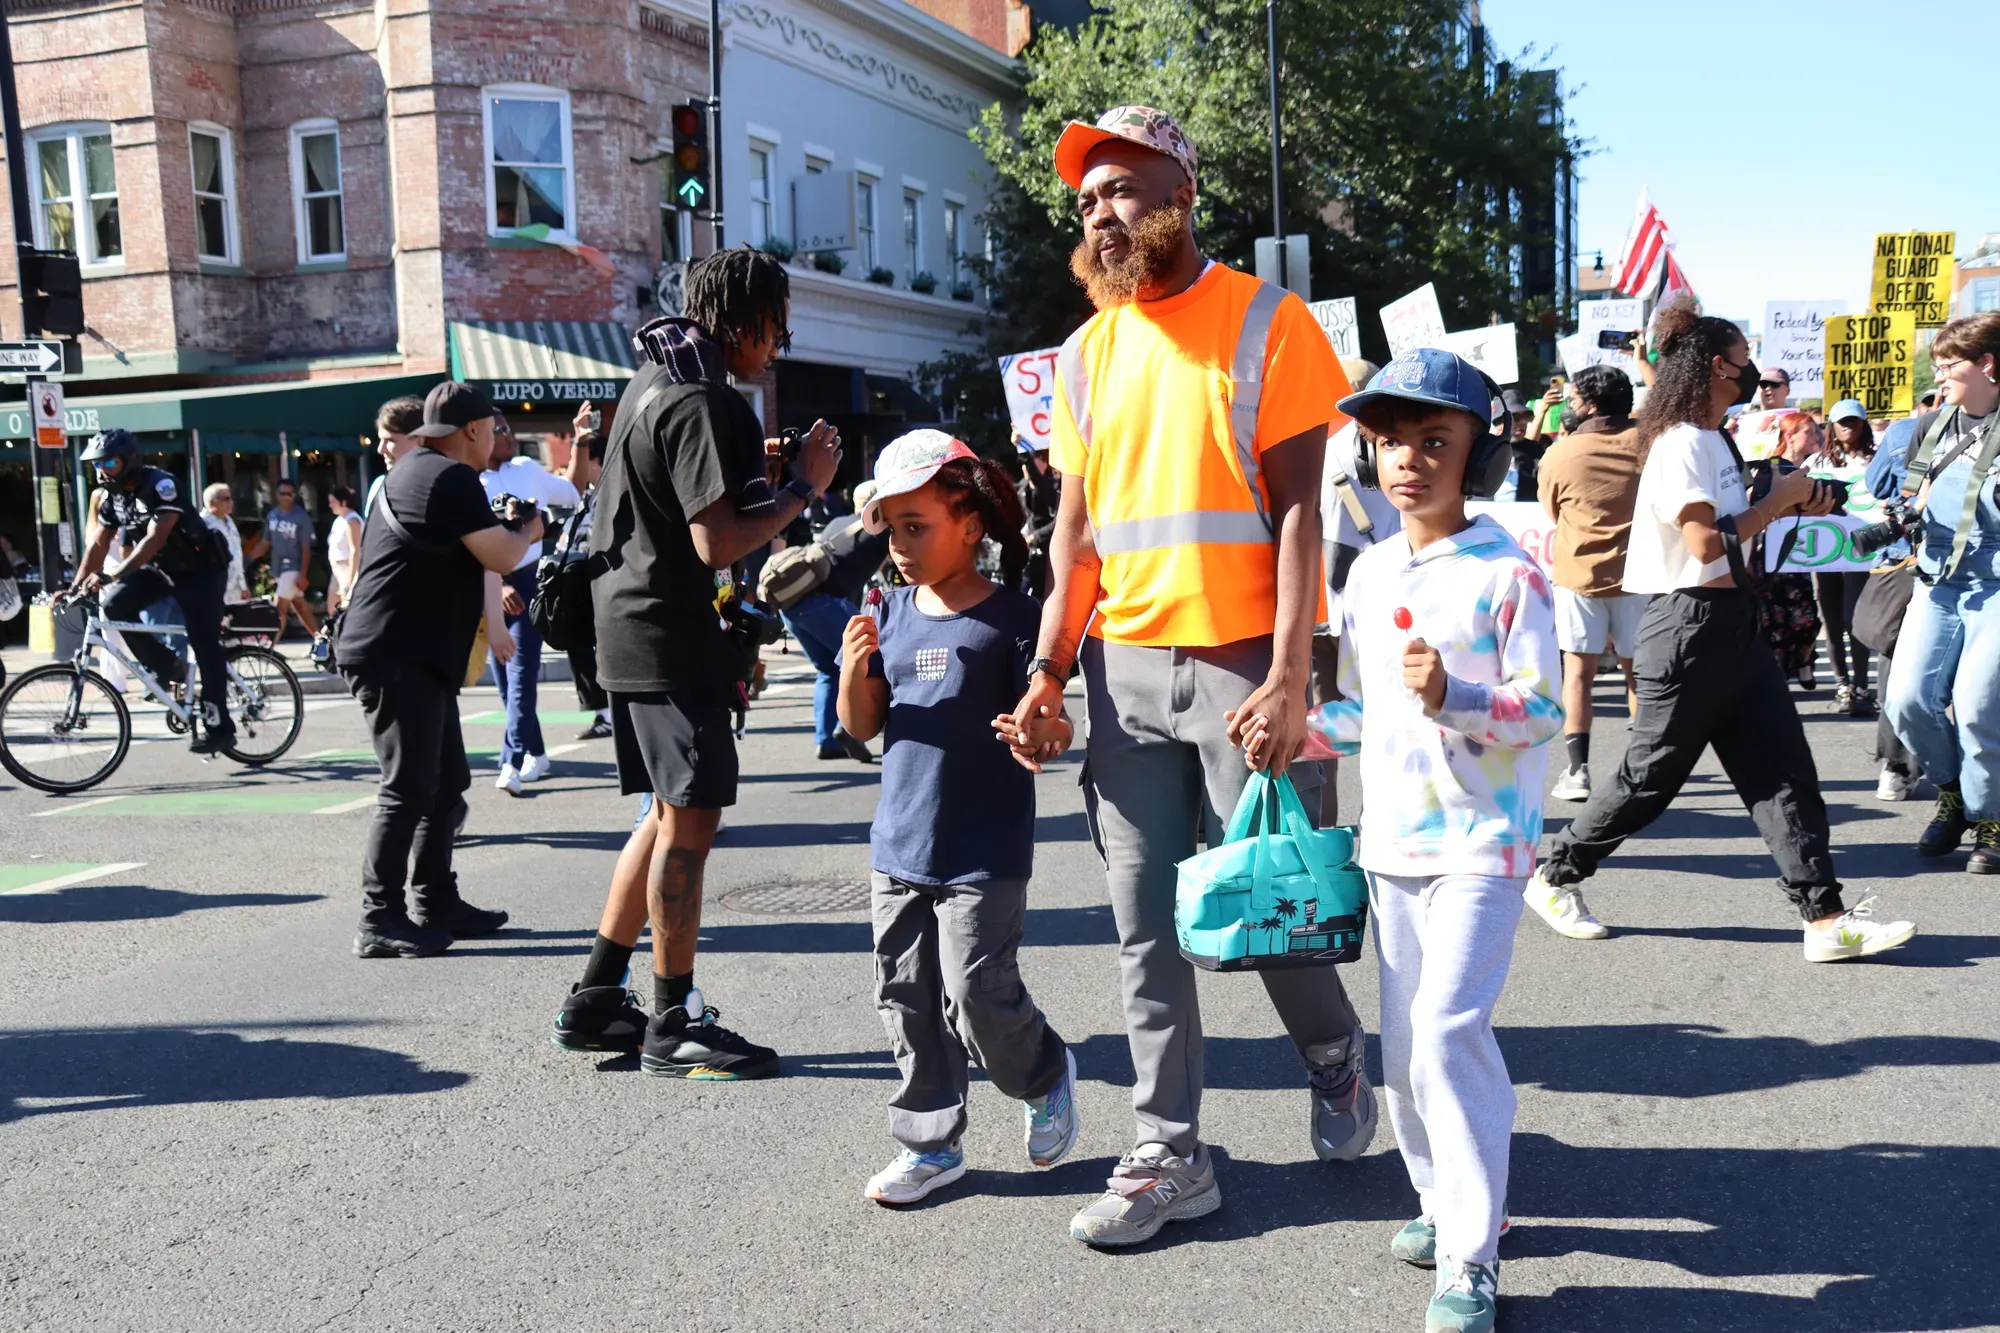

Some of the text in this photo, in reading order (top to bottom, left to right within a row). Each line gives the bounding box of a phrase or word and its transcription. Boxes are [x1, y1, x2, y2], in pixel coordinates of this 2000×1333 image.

[1876, 234, 1952, 257] NATIONAL
[1886, 257, 1938, 278] GUARD
[1885, 281, 1935, 302] OFF DC
[1845, 316, 1891, 341] STOP
[0, 352, 39, 364] NE WAY
[1831, 339, 1906, 366] TRUMP'S
[1829, 366, 1907, 391] TAKEOVER
[492, 382, 617, 400] LUPO VERDE
[1866, 387, 1894, 411] DC!
[917, 670, 946, 682] TOMMY
